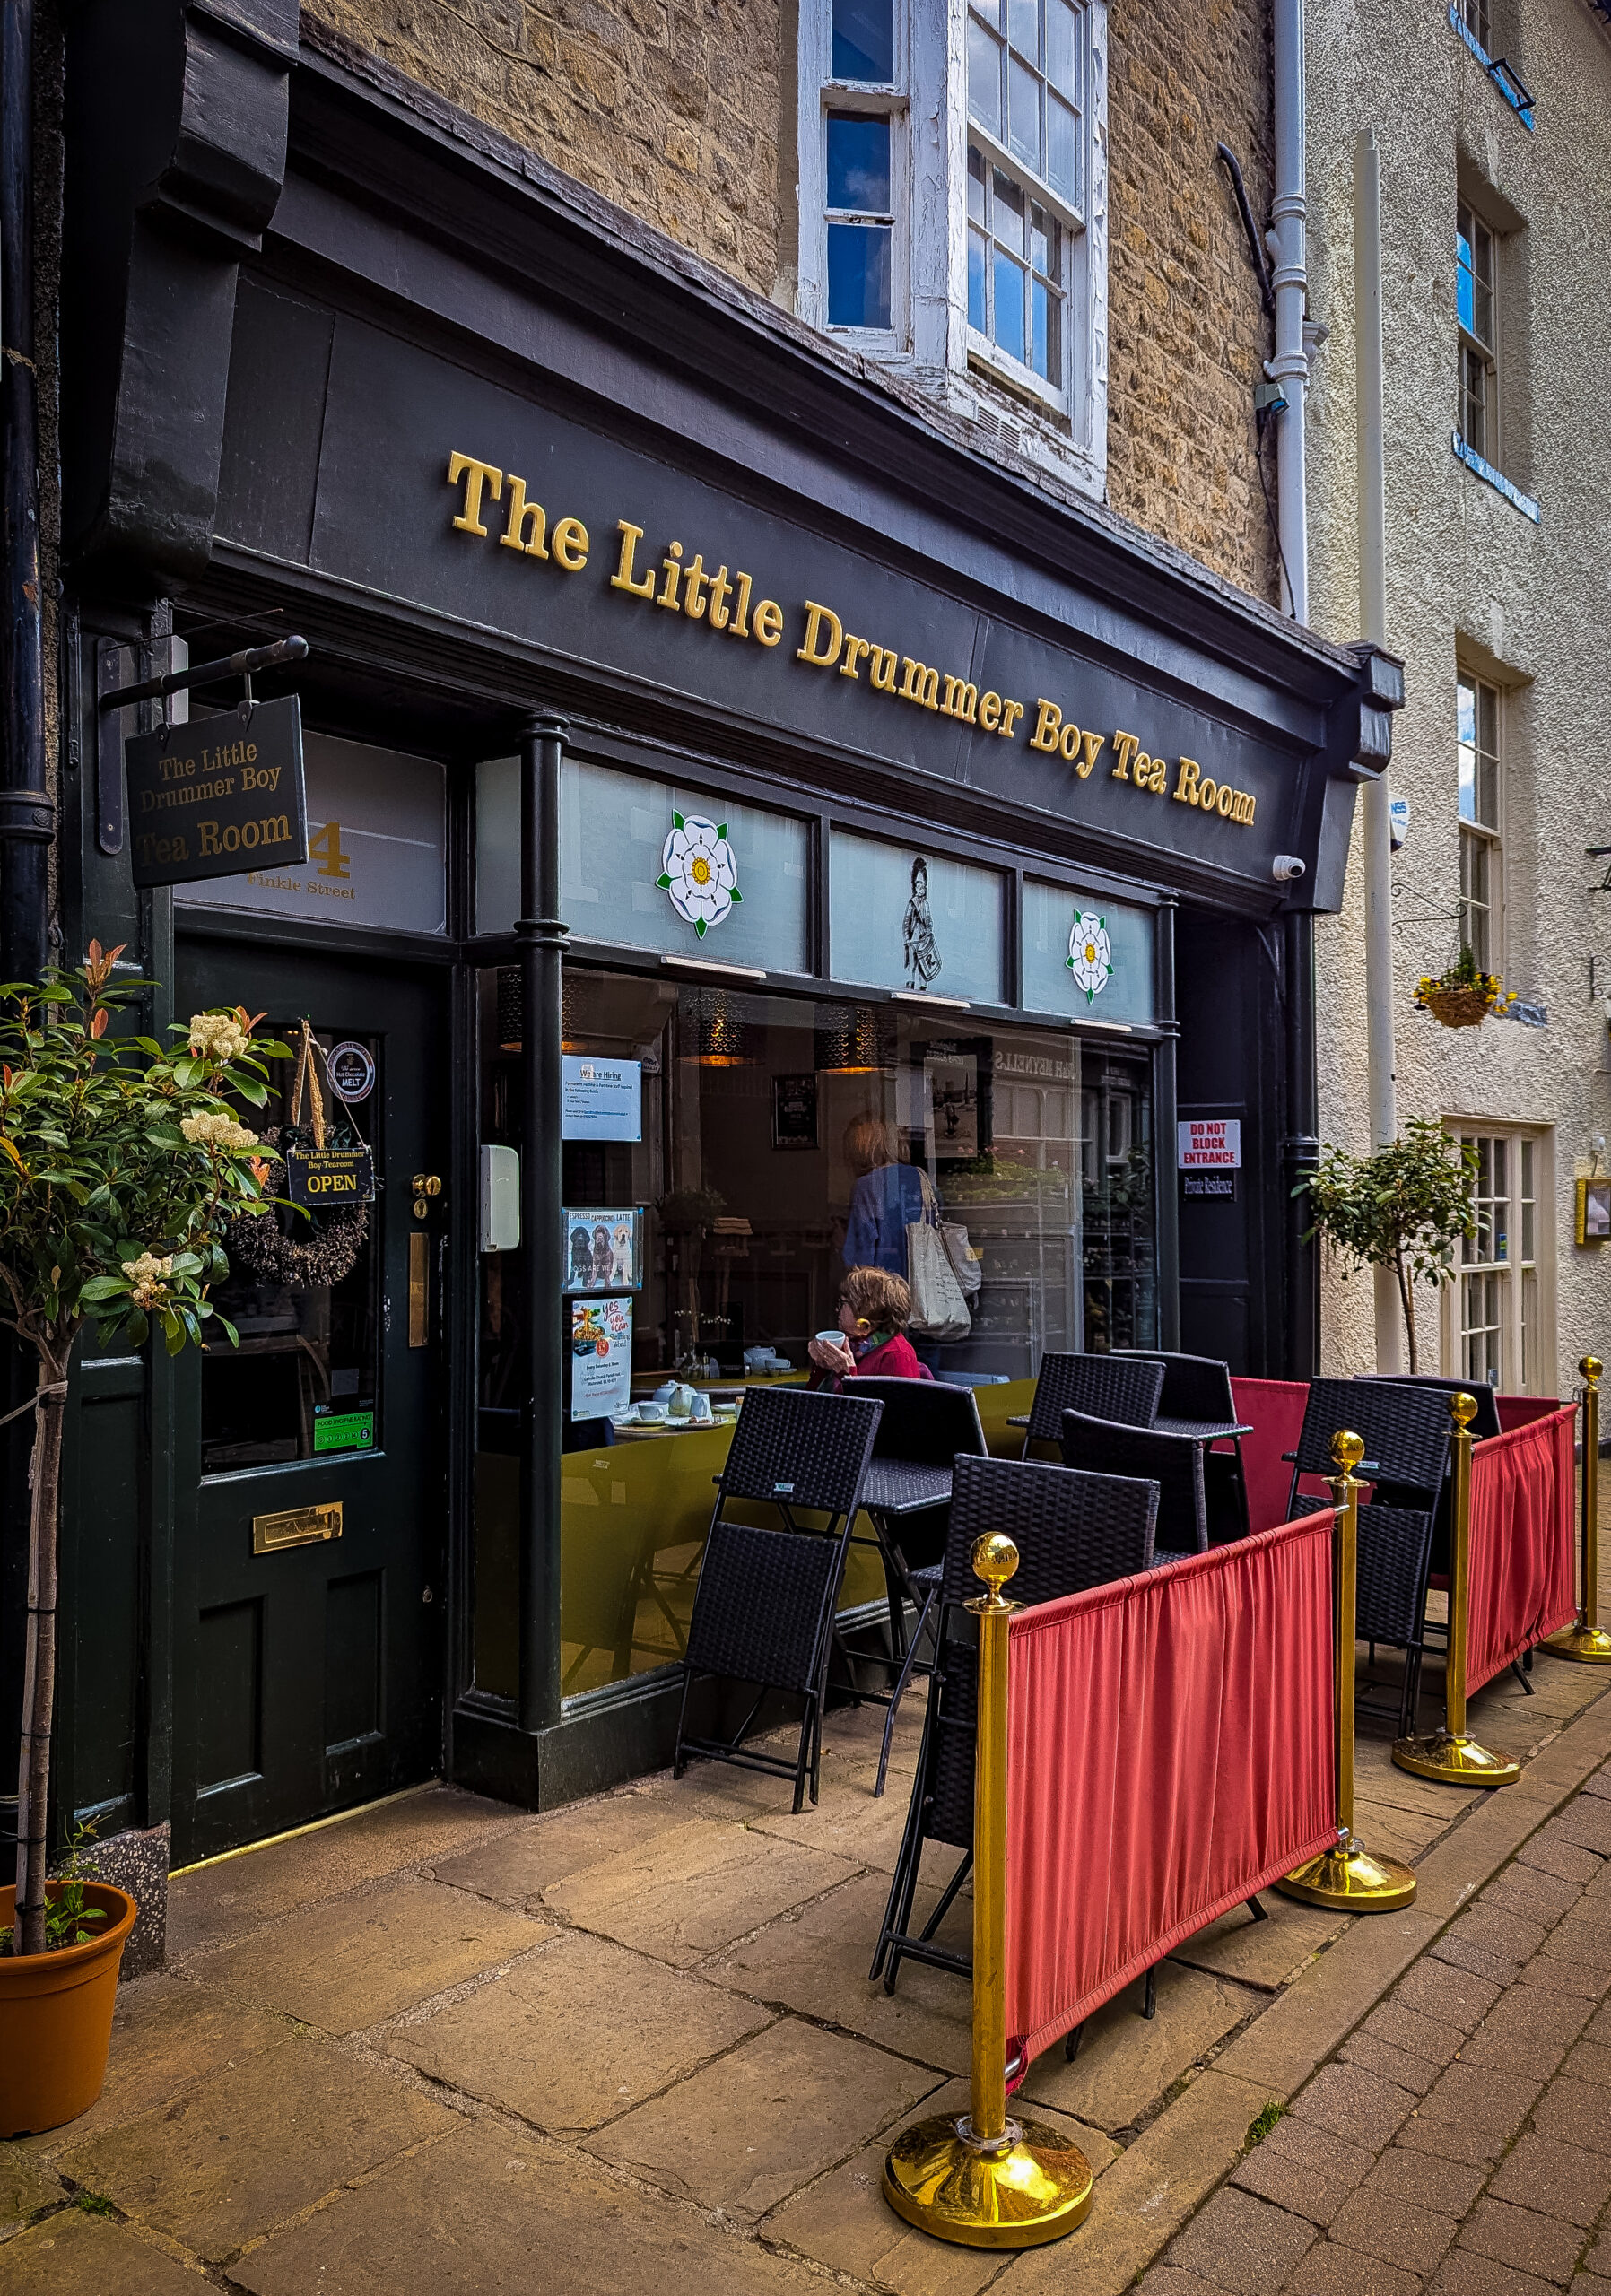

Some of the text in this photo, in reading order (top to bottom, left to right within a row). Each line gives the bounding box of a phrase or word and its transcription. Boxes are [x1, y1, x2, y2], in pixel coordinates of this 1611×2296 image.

[448, 450, 1256, 826] The Little Drummer Boy Tea Room
[159, 741, 257, 781] The Little
[140, 766, 282, 813] Drummer Boy
[136, 814, 292, 867] Tea Room
[248, 872, 356, 900] Finkle Street
[579, 1069, 591, 1077] We
[604, 1071, 622, 1081] Hiring
[342, 1078, 361, 1087] MELT
[1190, 1123, 1226, 1135] DO NOT
[1192, 1137, 1225, 1149] BLOCK
[295, 1151, 365, 1160] The Little Drummer
[1184, 1152, 1235, 1163] ENTRANCE
[308, 1161, 354, 1170] Boy Tearoom
[307, 1174, 357, 1193] OPEN
[616, 1213, 630, 1222] LATTE
[602, 1301, 619, 1322] yes
[610, 1314, 624, 1331] you
[614, 1322, 629, 1332] can
[333, 1417, 353, 1425] HYGIENE
[361, 1429, 368, 1439] 5
